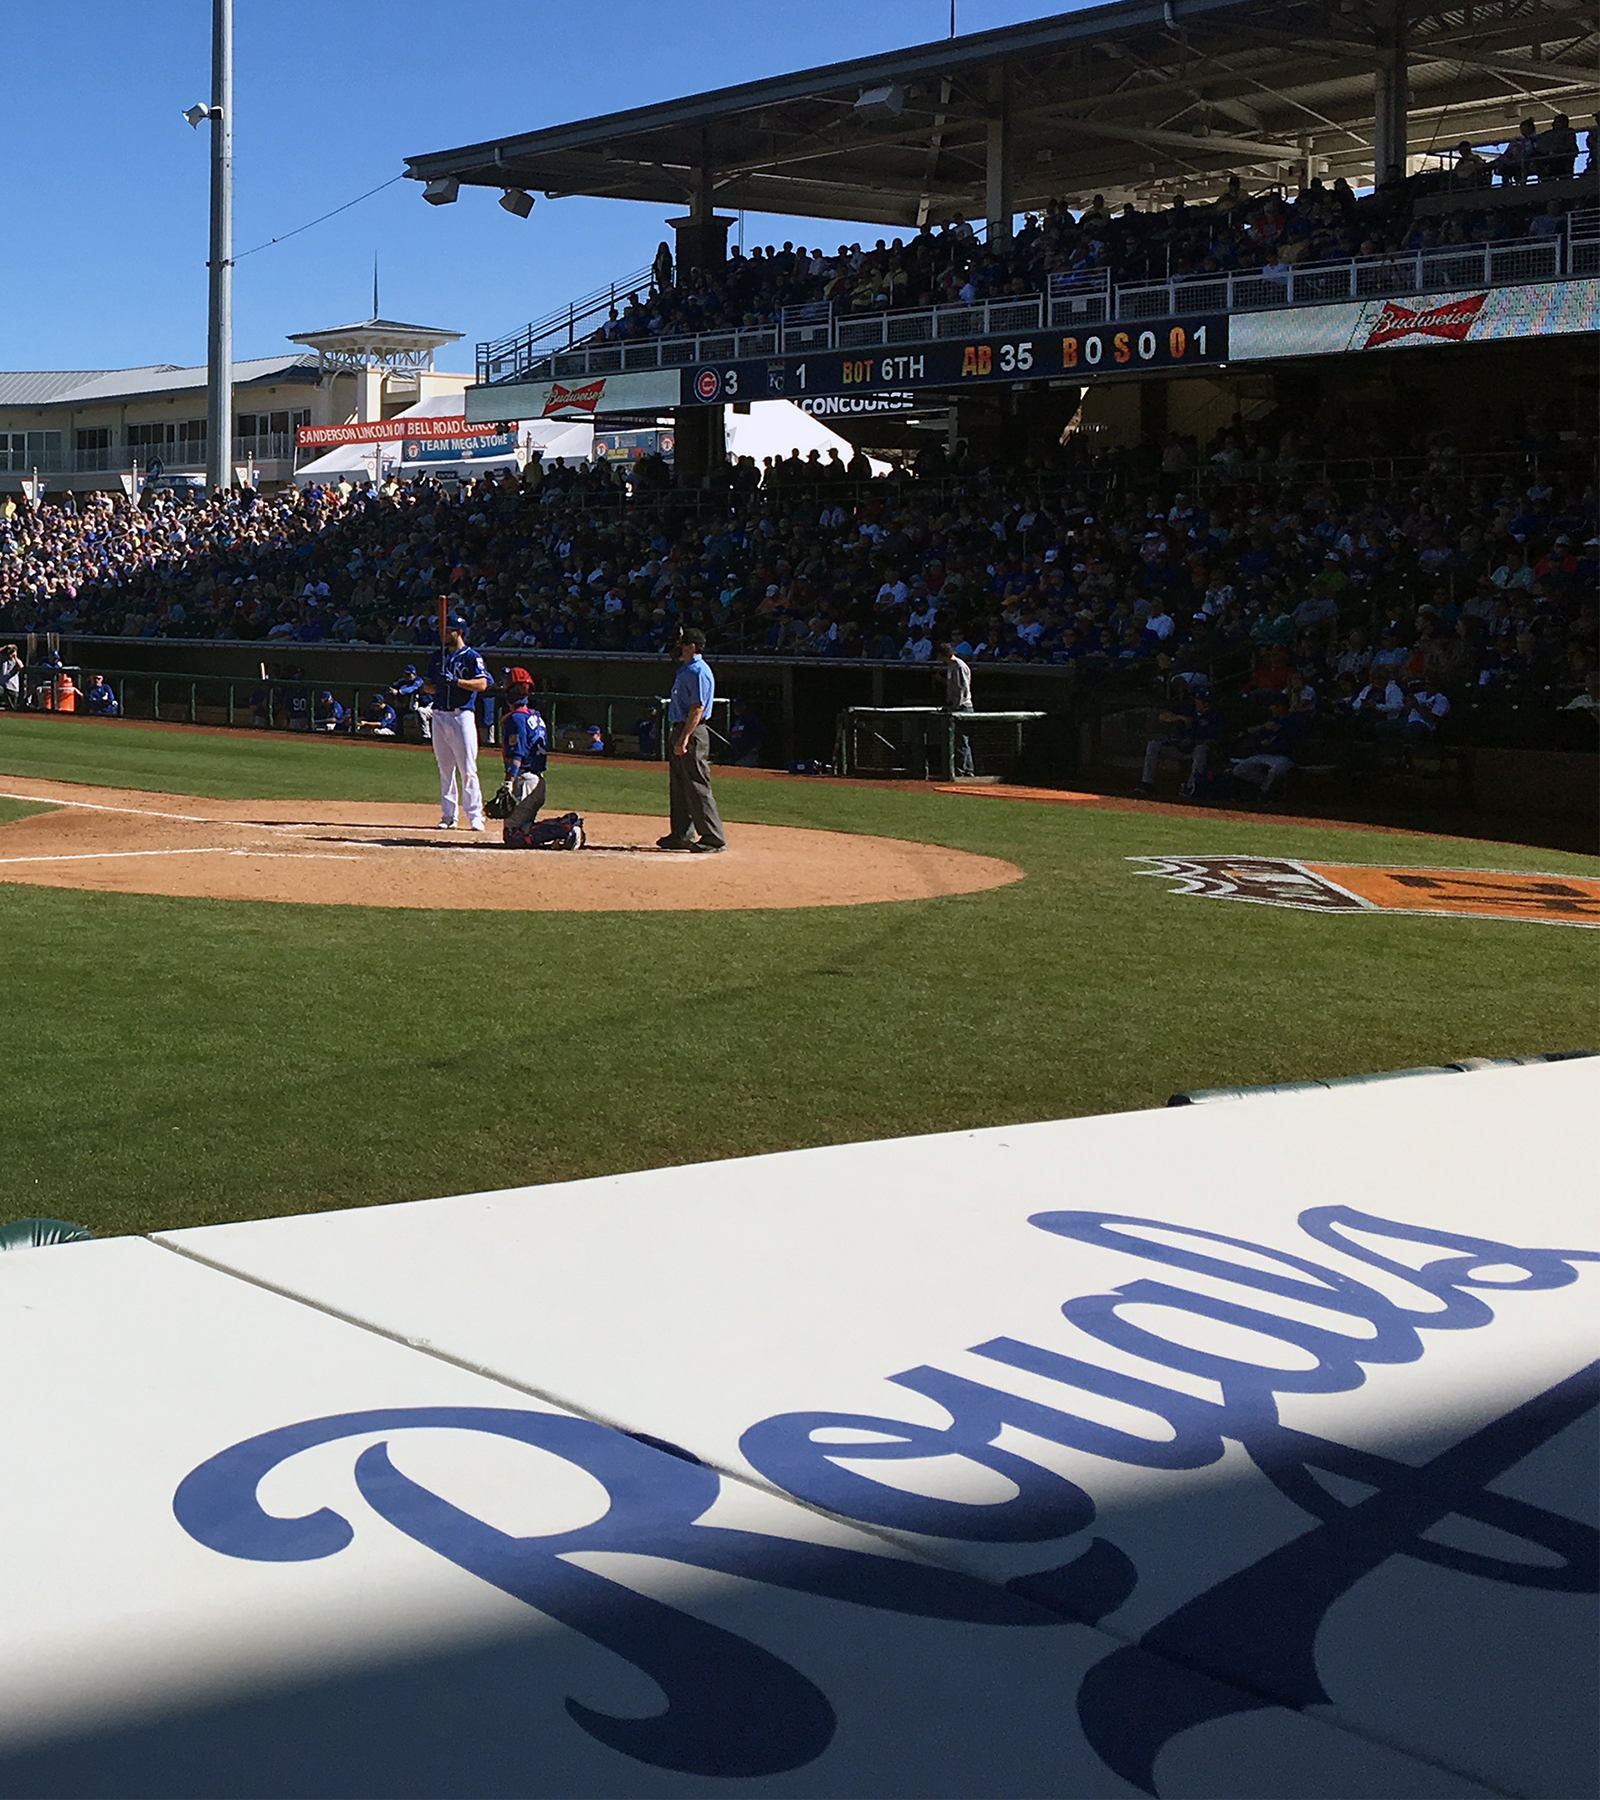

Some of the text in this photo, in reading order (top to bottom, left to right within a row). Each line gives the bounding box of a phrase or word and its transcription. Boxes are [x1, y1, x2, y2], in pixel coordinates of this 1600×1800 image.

[1364, 308, 1488, 335] Budweiser
[961, 345, 992, 377] AB
[1000, 342, 1033, 372] 35
[1062, 336, 1078, 368] B
[1113, 332, 1130, 363] S
[1193, 325, 1206, 355] 1
[725, 370, 738, 395] 3
[796, 363, 806, 389] 1
[842, 355, 924, 384] BOT 6TH
[300, 425, 358, 444] SANDERSON
[358, 423, 394, 440] LINCOLN
[407, 421, 432, 436] BELL
[433, 420, 461, 435] ROAD
[420, 433, 508, 452] TEAM MEGA STORE
[172, 1202, 1600, 1800] Royals
